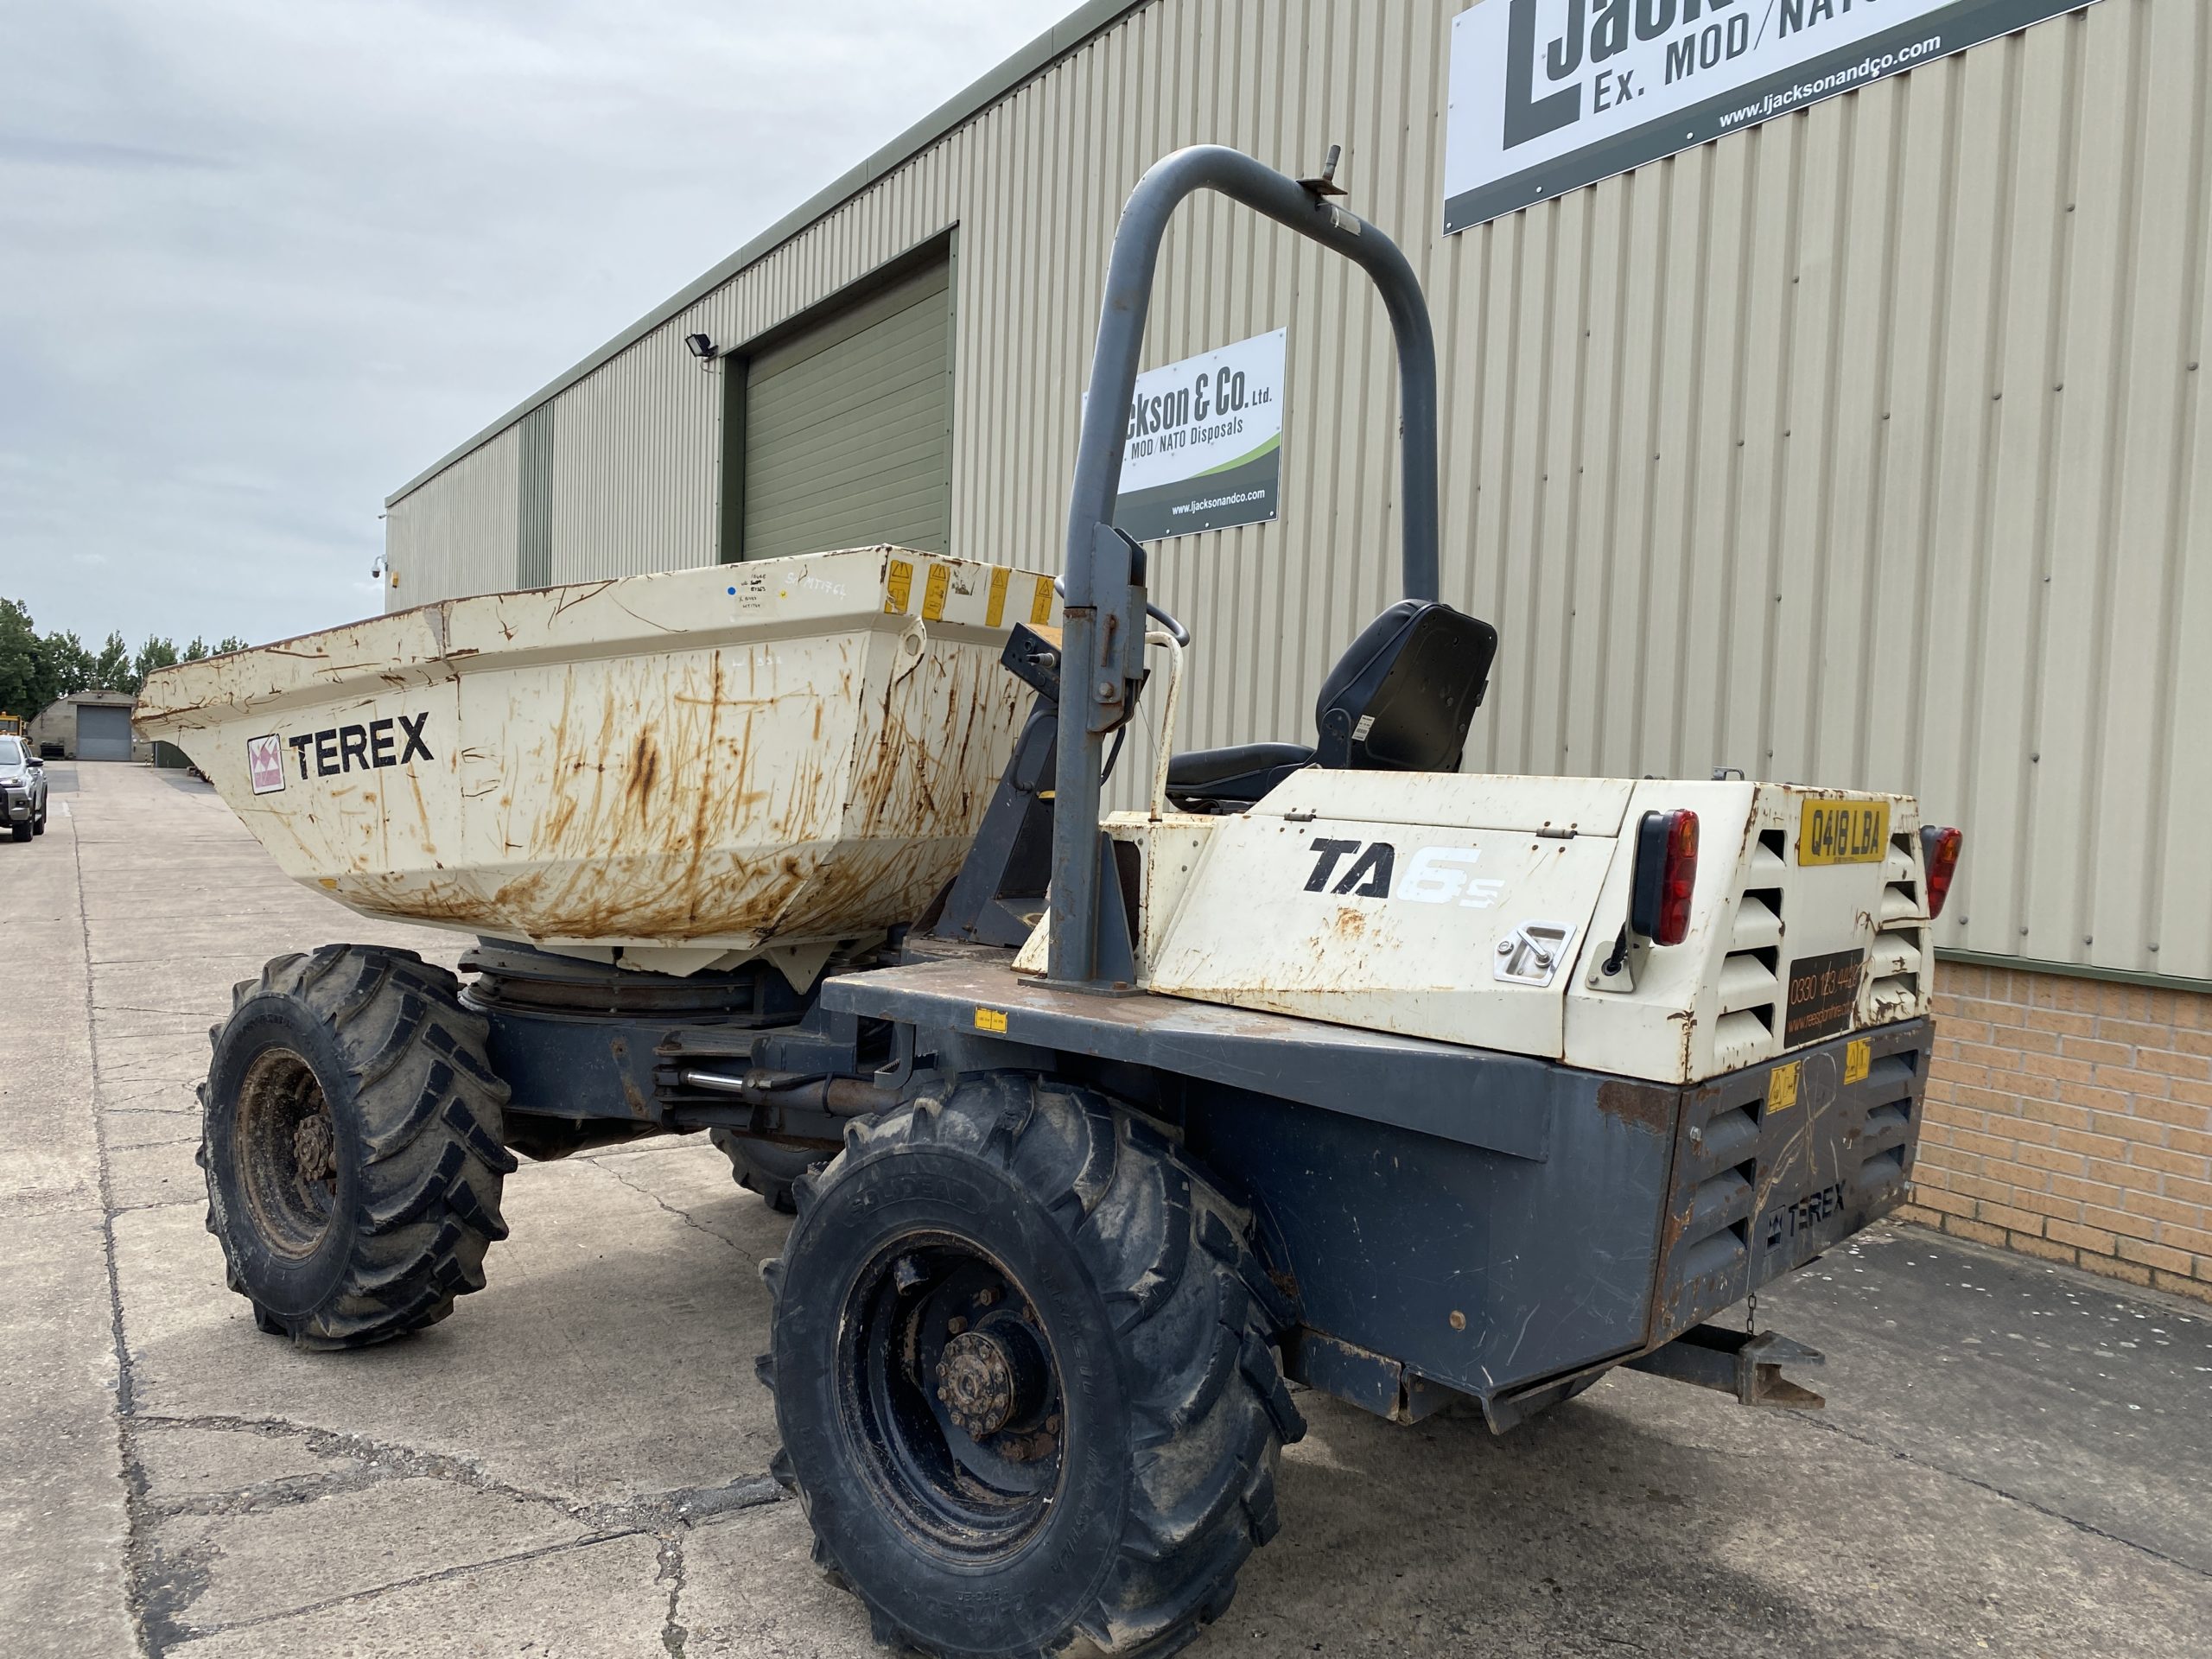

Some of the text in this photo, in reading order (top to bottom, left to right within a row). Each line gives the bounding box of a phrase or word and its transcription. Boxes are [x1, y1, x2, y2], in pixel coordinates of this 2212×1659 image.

[1593, 69, 1645, 115] Ex.
[1719, 35, 1942, 128] www.ljacksonandco.com
[1126, 366, 1273, 441] ckson & Co. Ltd.
[1131, 416, 1243, 460] MOD/NATO Disposals
[1172, 488, 1266, 516] www.ljacksonandco.com
[289, 711, 435, 780] TEREX
[1790, 974, 1818, 1006] 0330
[1821, 969, 1837, 996] 123
[1788, 1178, 1847, 1237] TEREX
